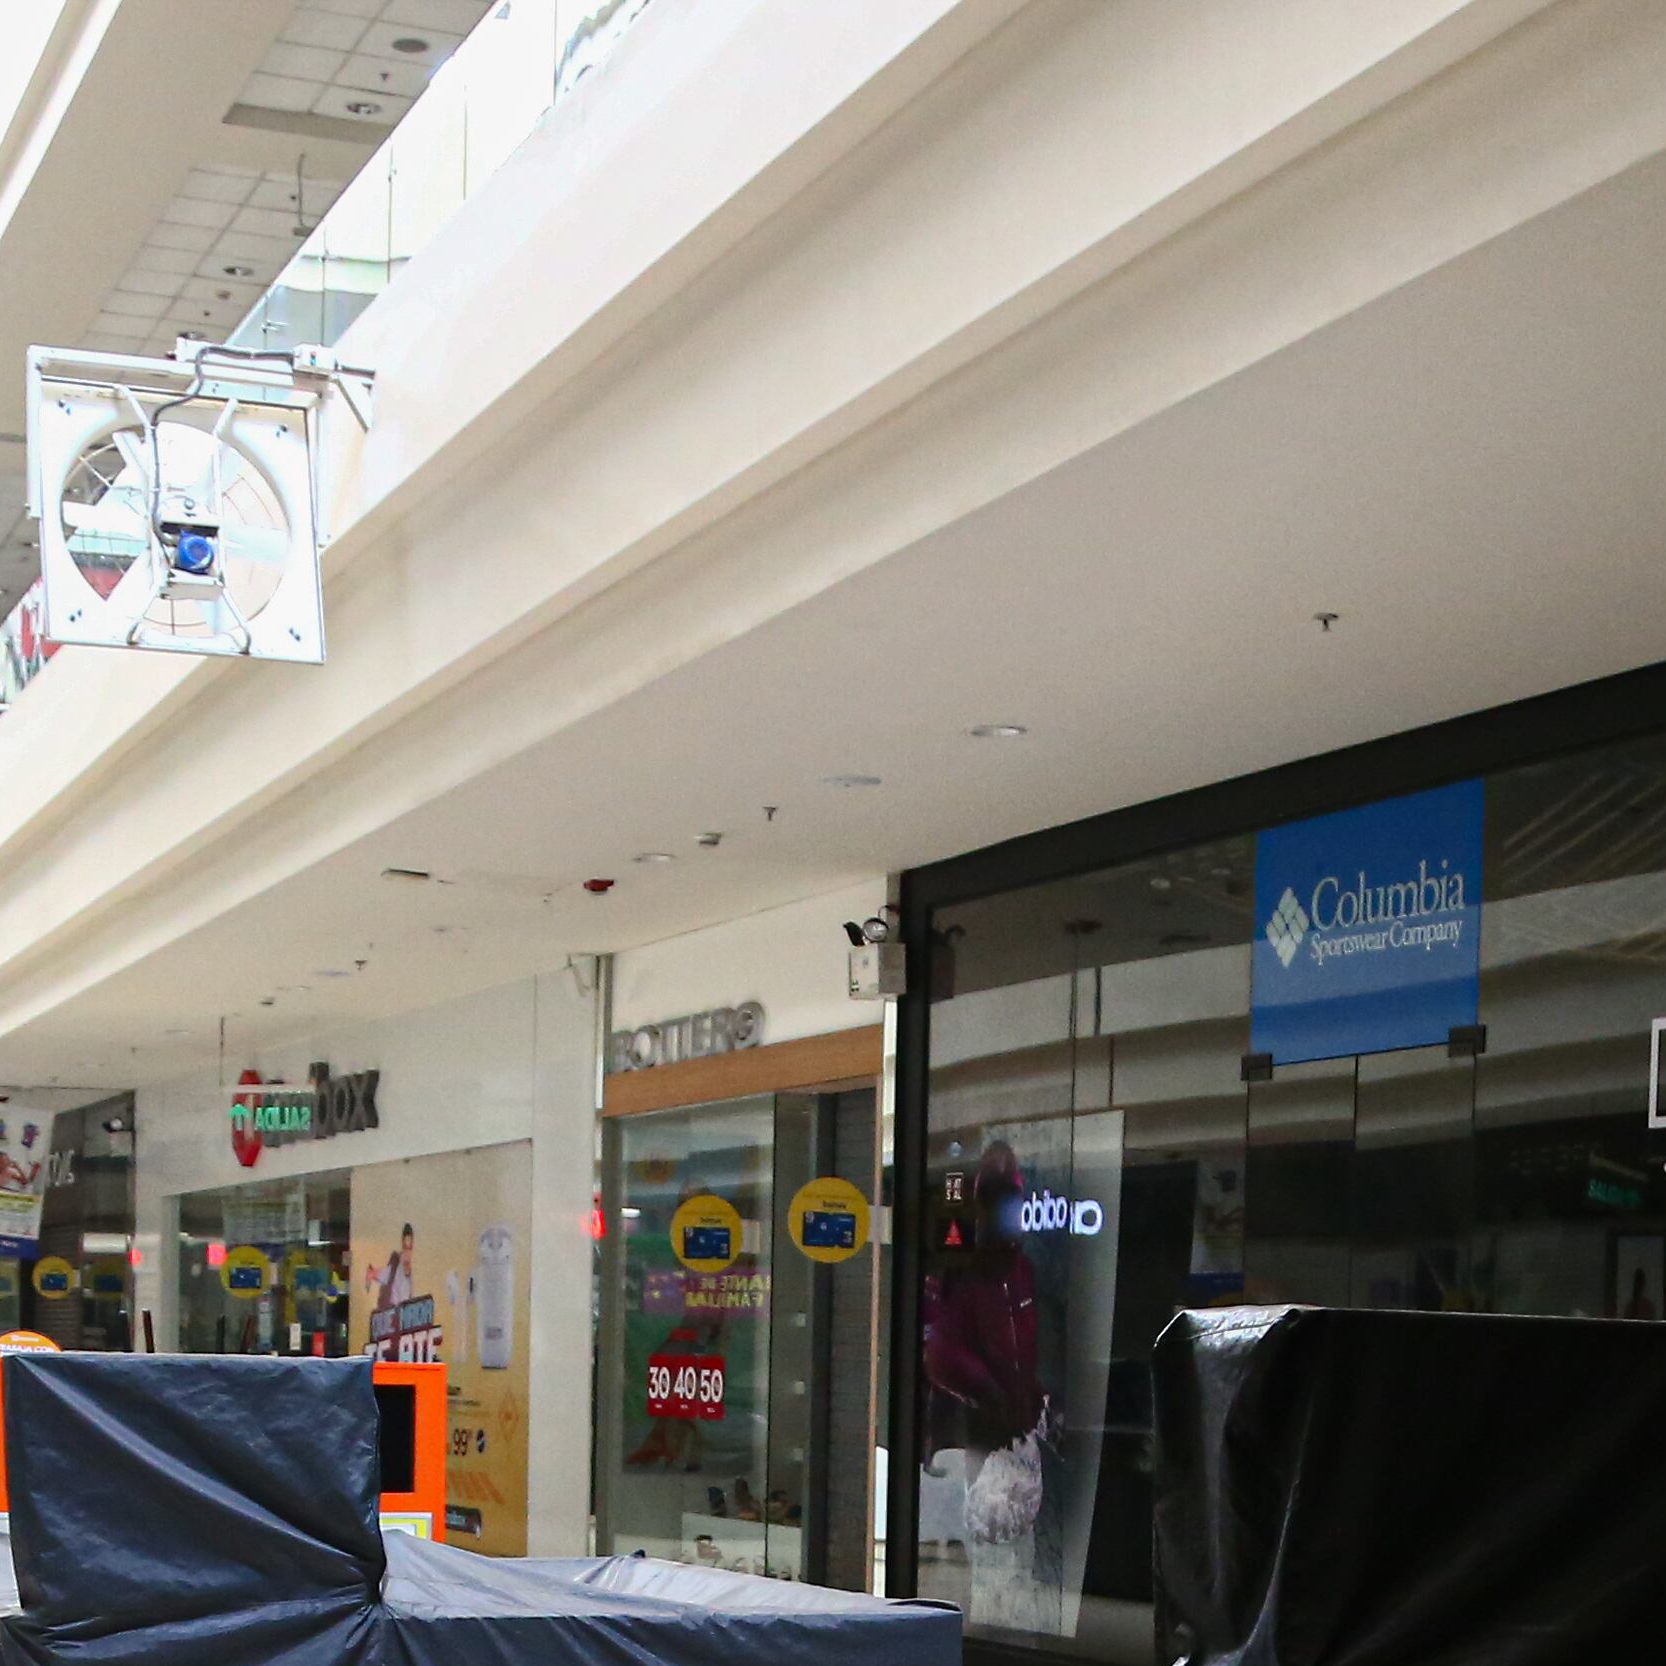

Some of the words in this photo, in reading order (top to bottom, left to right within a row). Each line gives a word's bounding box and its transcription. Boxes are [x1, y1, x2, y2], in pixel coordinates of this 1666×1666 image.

[1312, 858, 1466, 932] Columbia
[1310, 931, 1389, 966] Sportswear
[1389, 919, 1464, 951] Company
[648, 1366, 671, 1399] 30
[674, 1366, 696, 1400] 40
[700, 1370, 723, 1403] 50
